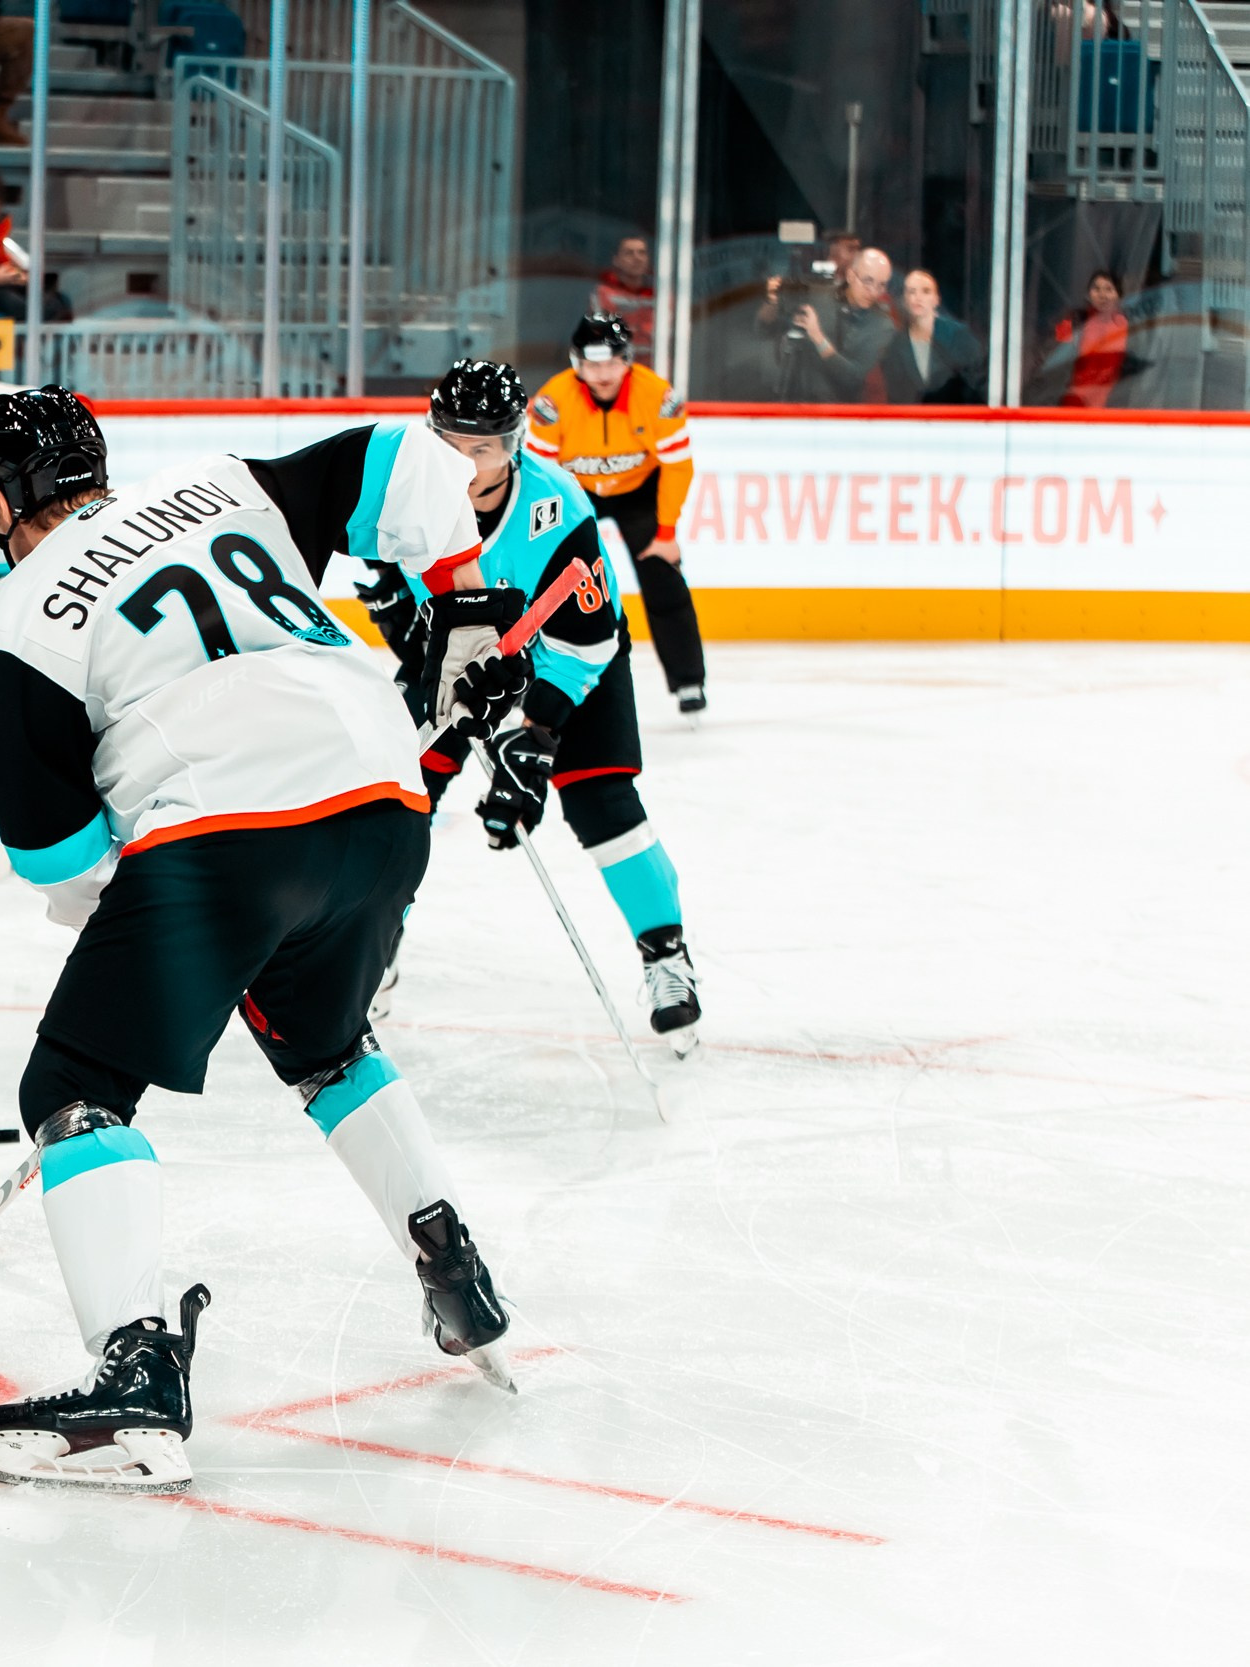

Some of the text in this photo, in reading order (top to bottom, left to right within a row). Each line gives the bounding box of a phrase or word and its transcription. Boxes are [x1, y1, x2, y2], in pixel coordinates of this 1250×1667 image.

[55, 471, 93, 484] TRUE
[688, 471, 1135, 546] ARWEEK.COM
[43, 481, 242, 630] SHALUNOV
[115, 531, 352, 662] 78
[454, 595, 489, 604] TRUE
[573, 556, 610, 614] 87
[416, 1206, 443, 1224] CCM
